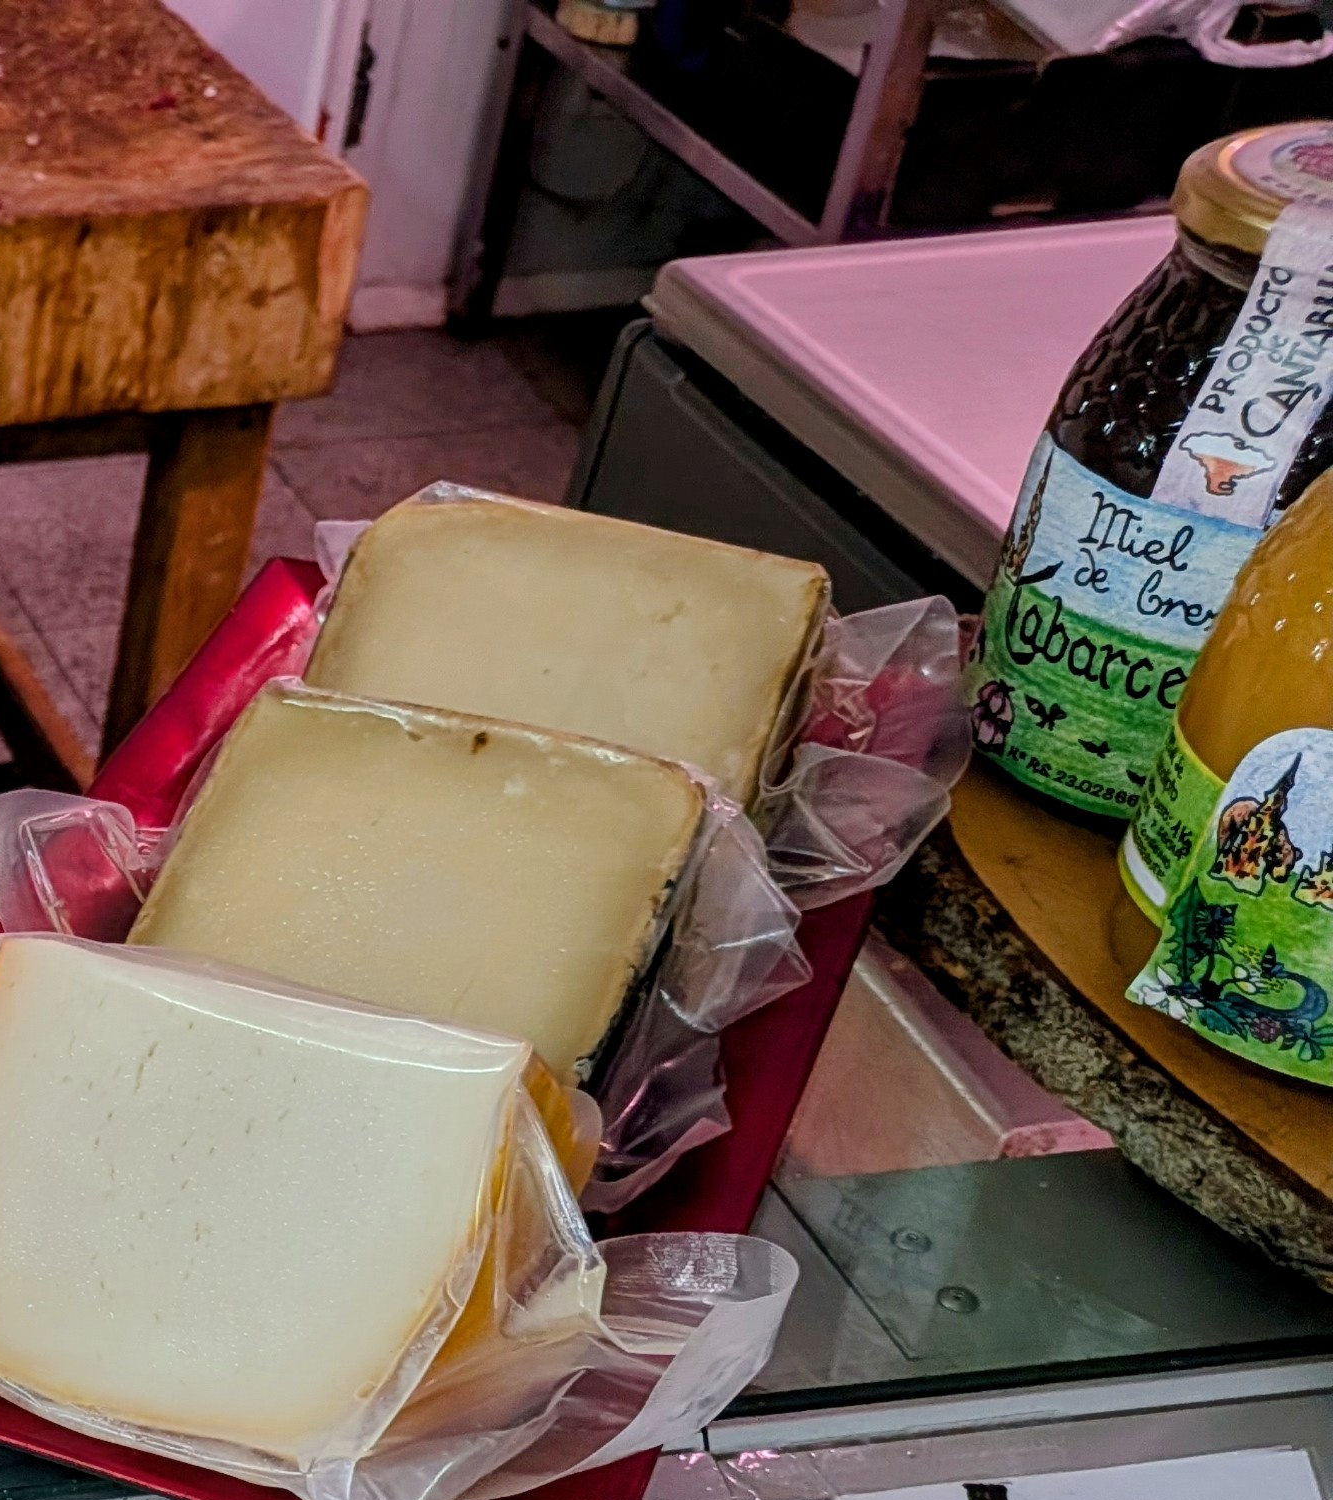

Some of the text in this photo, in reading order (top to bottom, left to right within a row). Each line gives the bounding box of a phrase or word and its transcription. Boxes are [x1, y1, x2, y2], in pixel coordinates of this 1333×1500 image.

[1199, 266, 1292, 414] PRODUCTO
[1078, 492, 1194, 572] Miel
[1073, 547, 1110, 594] de
[1136, 569, 1219, 632] bre
